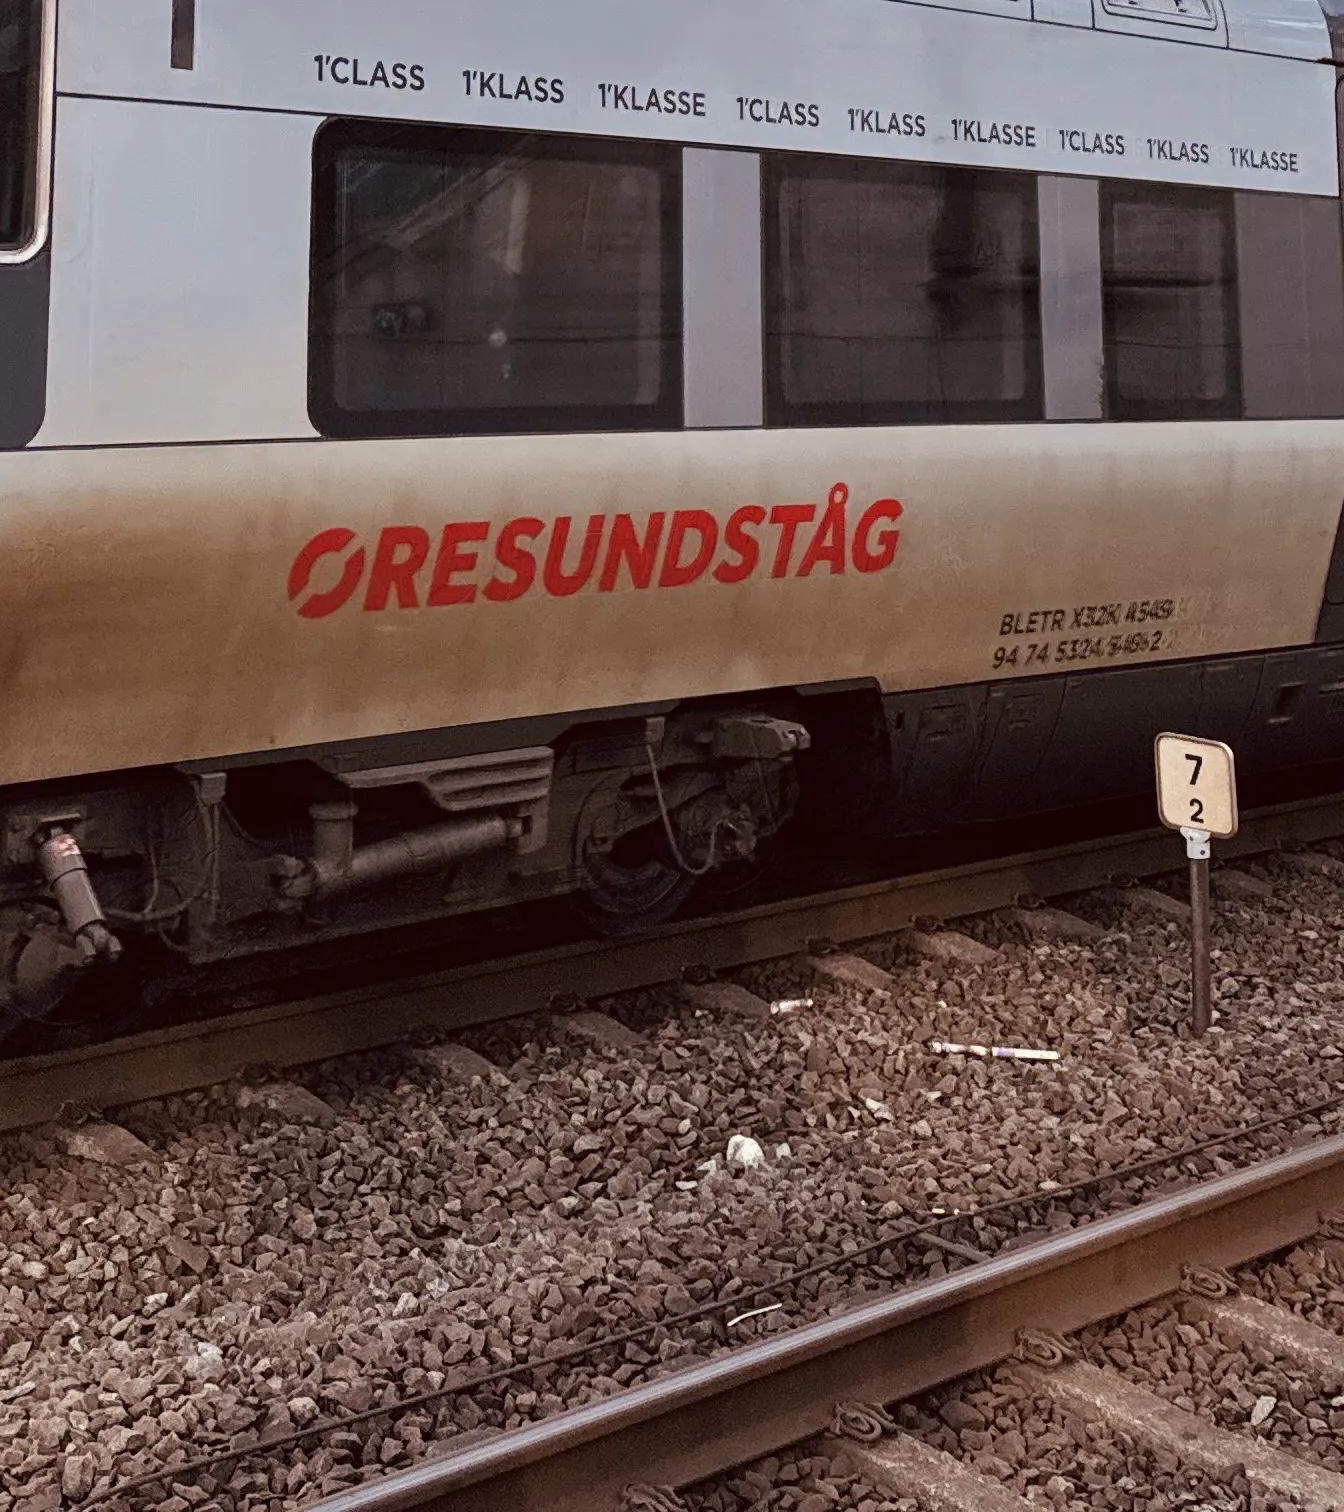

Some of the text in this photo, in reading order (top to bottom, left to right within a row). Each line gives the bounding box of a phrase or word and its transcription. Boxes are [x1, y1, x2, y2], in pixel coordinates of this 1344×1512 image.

[313, 54, 426, 91] 1'CLASS
[462, 69, 565, 104] 1'KLASS
[598, 83, 706, 117] 1'KLASSE
[736, 96, 820, 128] 1'CLASS
[847, 107, 926, 137] 1'KLASS
[951, 118, 1036, 148] 1'KLASSE
[1058, 129, 1125, 156] 1'CLASS
[1146, 138, 1210, 165] 1'KLASS
[998, 608, 1065, 637] BLETR
[992, 646, 1019, 670] 94
[1024, 642, 1050, 667] 74
[1184, 753, 1203, 785] 7
[1189, 797, 1204, 824] 2
